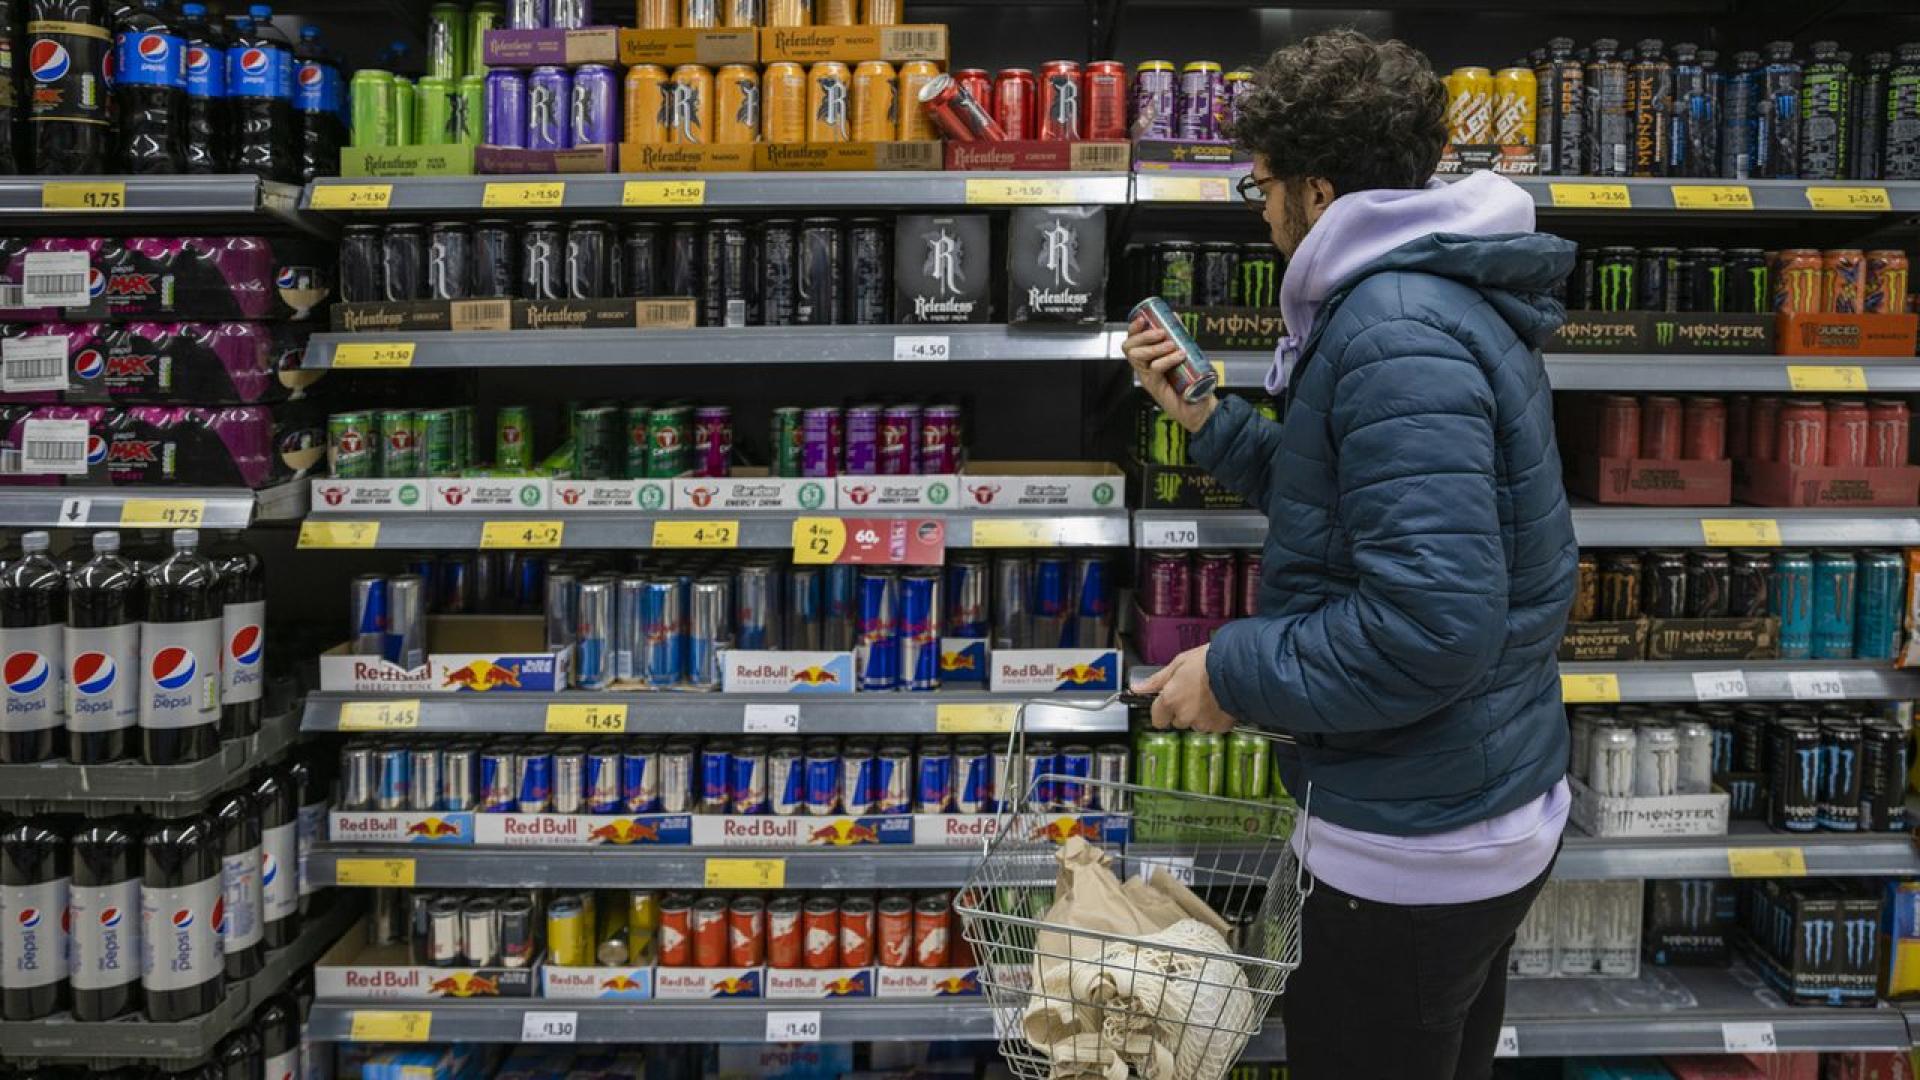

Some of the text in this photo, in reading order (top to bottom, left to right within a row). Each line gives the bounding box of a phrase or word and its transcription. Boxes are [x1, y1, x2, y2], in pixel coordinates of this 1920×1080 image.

[775, 31, 837, 54] Relentless
[365, 154, 418, 174] Relentless
[642, 146, 703, 169] Relentless
[767, 146, 829, 168] Relentless
[955, 147, 1015, 168] Relentless
[84, 191, 121, 208] £1.75
[1028, 286, 1090, 313] Relentless
[914, 295, 977, 321] Relentless
[344, 311, 403, 331] Relentless
[527, 306, 588, 328] Relentless
[1206, 315, 1283, 336] MONST
[1679, 324, 1764, 340] MONSTER
[911, 345, 946, 357] £4.50
[162, 508, 199, 523] £1.75
[523, 529, 532, 542] 4
[694, 528, 703, 541] 4
[809, 524, 818, 535] 4
[1164, 530, 1195, 543] £1.70
[810, 537, 829, 554] £2
[737, 665, 787, 677] Red Bull
[1002, 665, 1054, 676] Red Bull
[7, 699, 45, 713] pepsi
[75, 700, 113, 713] pepsi
[153, 695, 192, 711] pepsi
[586, 712, 622, 729] £1.45
[1638, 808, 1715, 820] MONSTER
[340, 818, 398, 831] Red Bull
[505, 818, 577, 835] Red Bull
[724, 820, 798, 836] Red Bull
[946, 818, 982, 835] Red
[22, 931, 39, 970] pepsi
[103, 931, 120, 970] pepsi
[176, 931, 193, 971] pepsi
[346, 971, 419, 987] Red Bull
[543, 1022, 573, 1035] £1.30
[786, 1022, 817, 1036] £1.40
